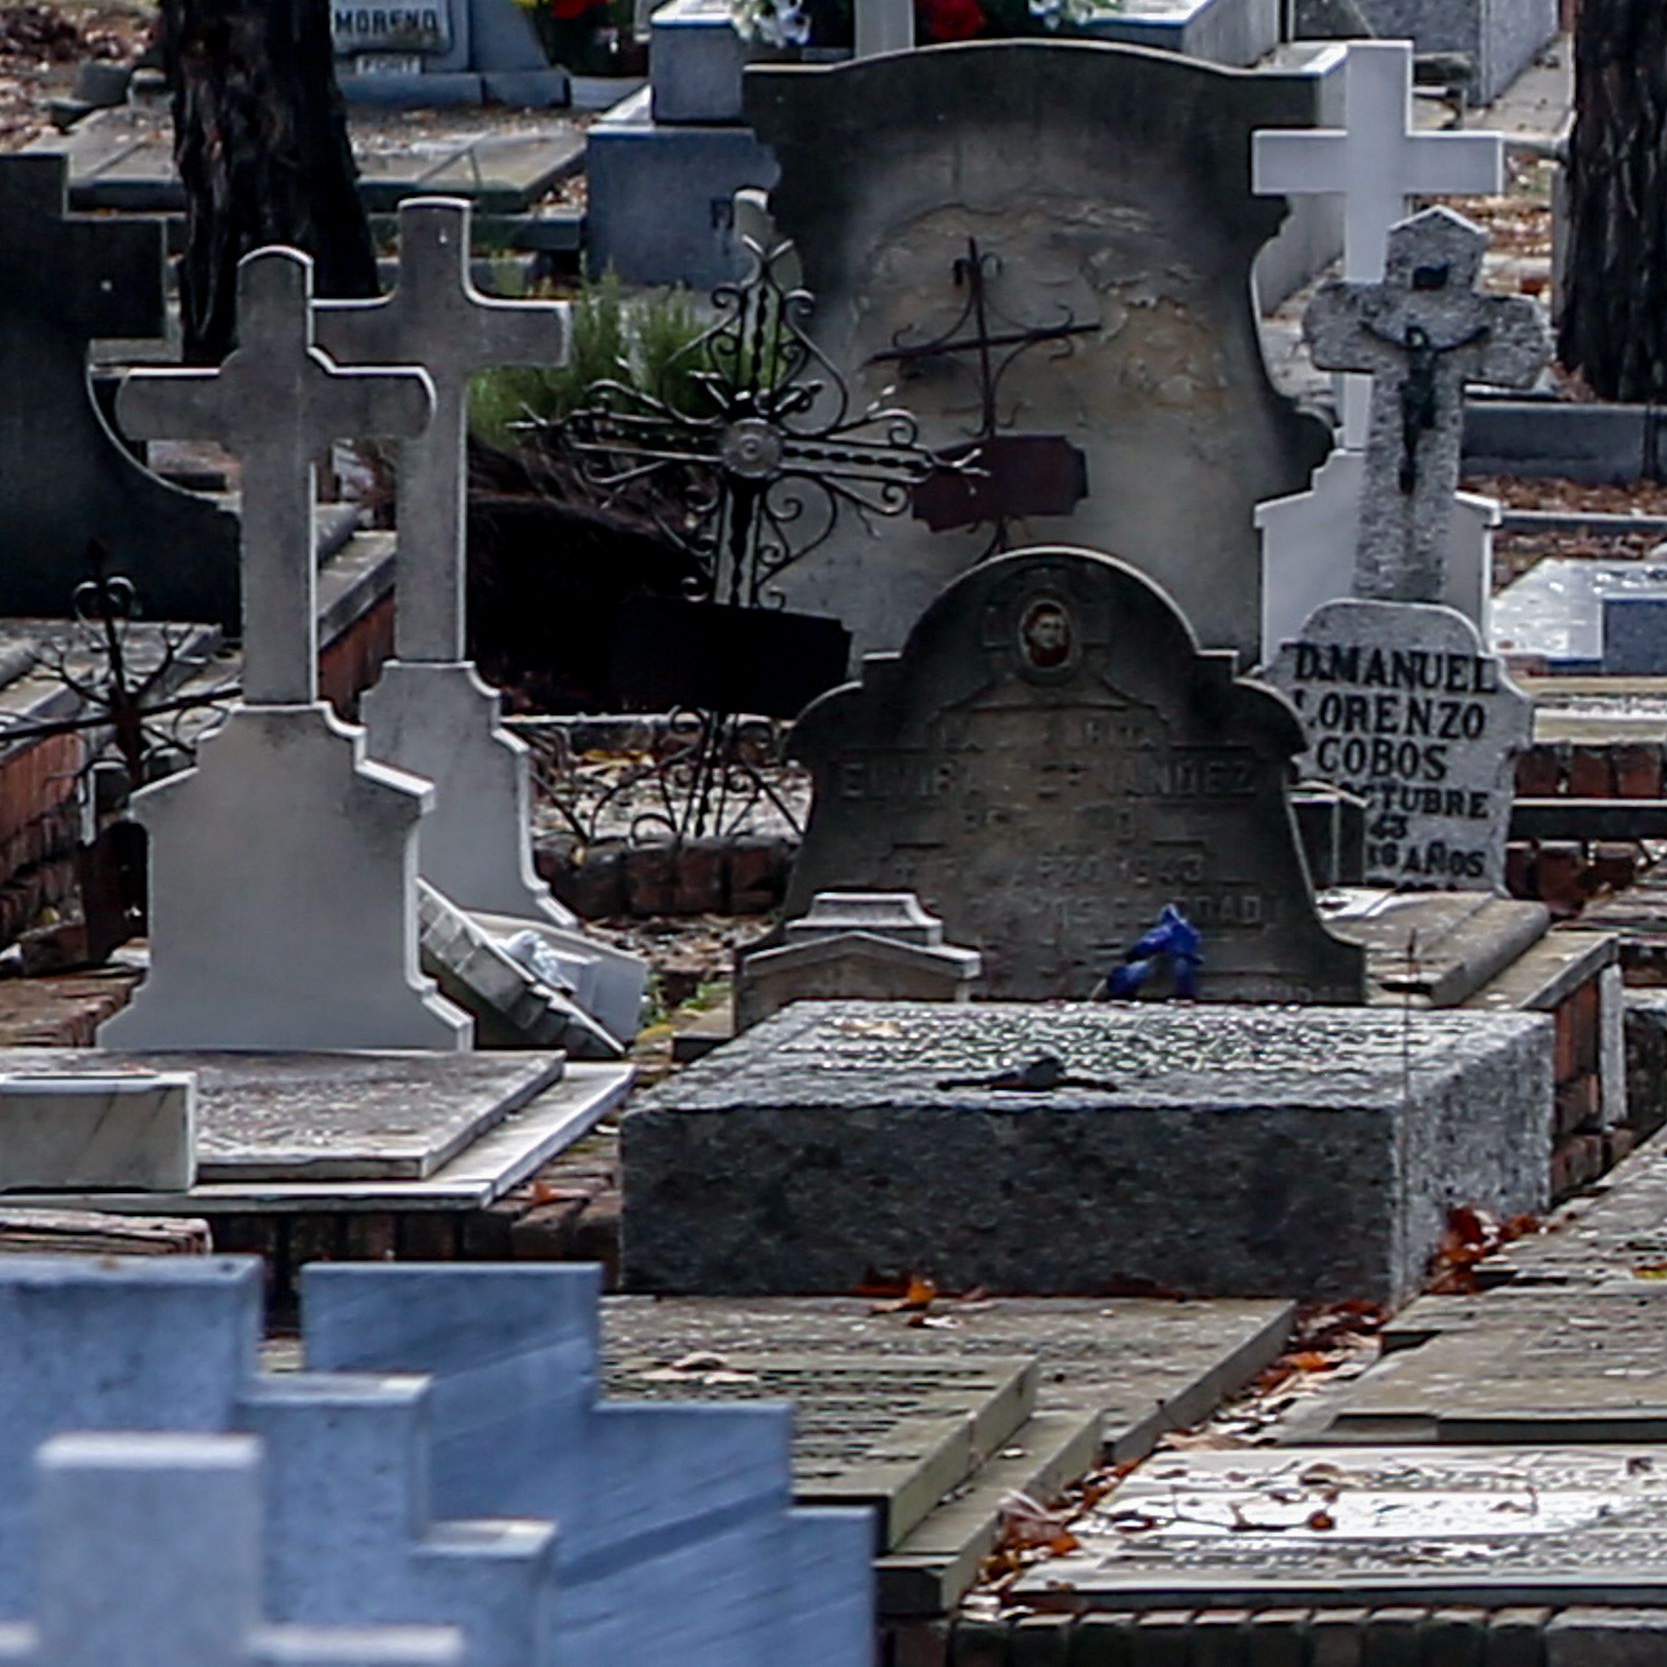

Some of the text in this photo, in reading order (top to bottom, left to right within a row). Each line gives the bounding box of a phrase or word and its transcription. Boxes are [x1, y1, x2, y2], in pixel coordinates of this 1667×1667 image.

[335, 8, 438, 34] MORENO
[1294, 688, 1486, 740] LORENZO
[1316, 736, 1448, 782] COBOS
[1361, 783, 1489, 819] CTUBRE
[1402, 841, 1486, 878] AÑOS
